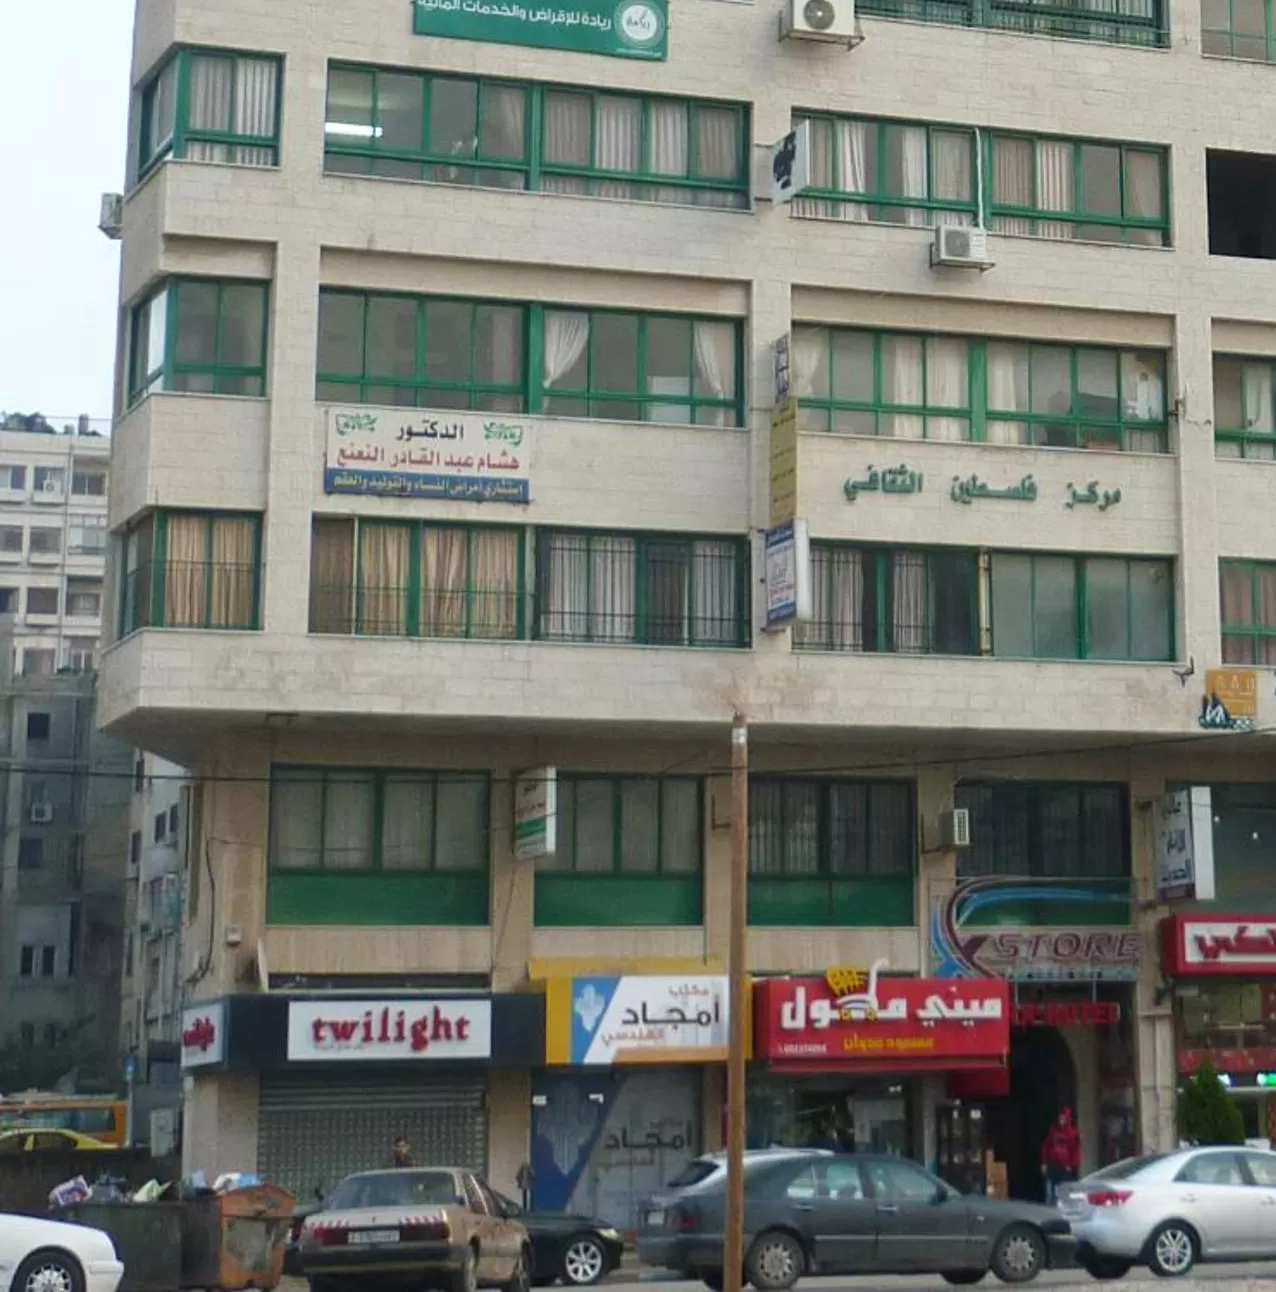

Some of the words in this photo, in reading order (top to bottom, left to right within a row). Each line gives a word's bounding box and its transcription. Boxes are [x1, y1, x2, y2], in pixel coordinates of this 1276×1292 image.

[396, 419, 465, 442] الدكتور
[843, 464, 924, 503] الثقافي
[950, 473, 1038, 505] فلسطين
[1066, 481, 1122, 512] مركز
[312, 1007, 470, 1051] twilight
